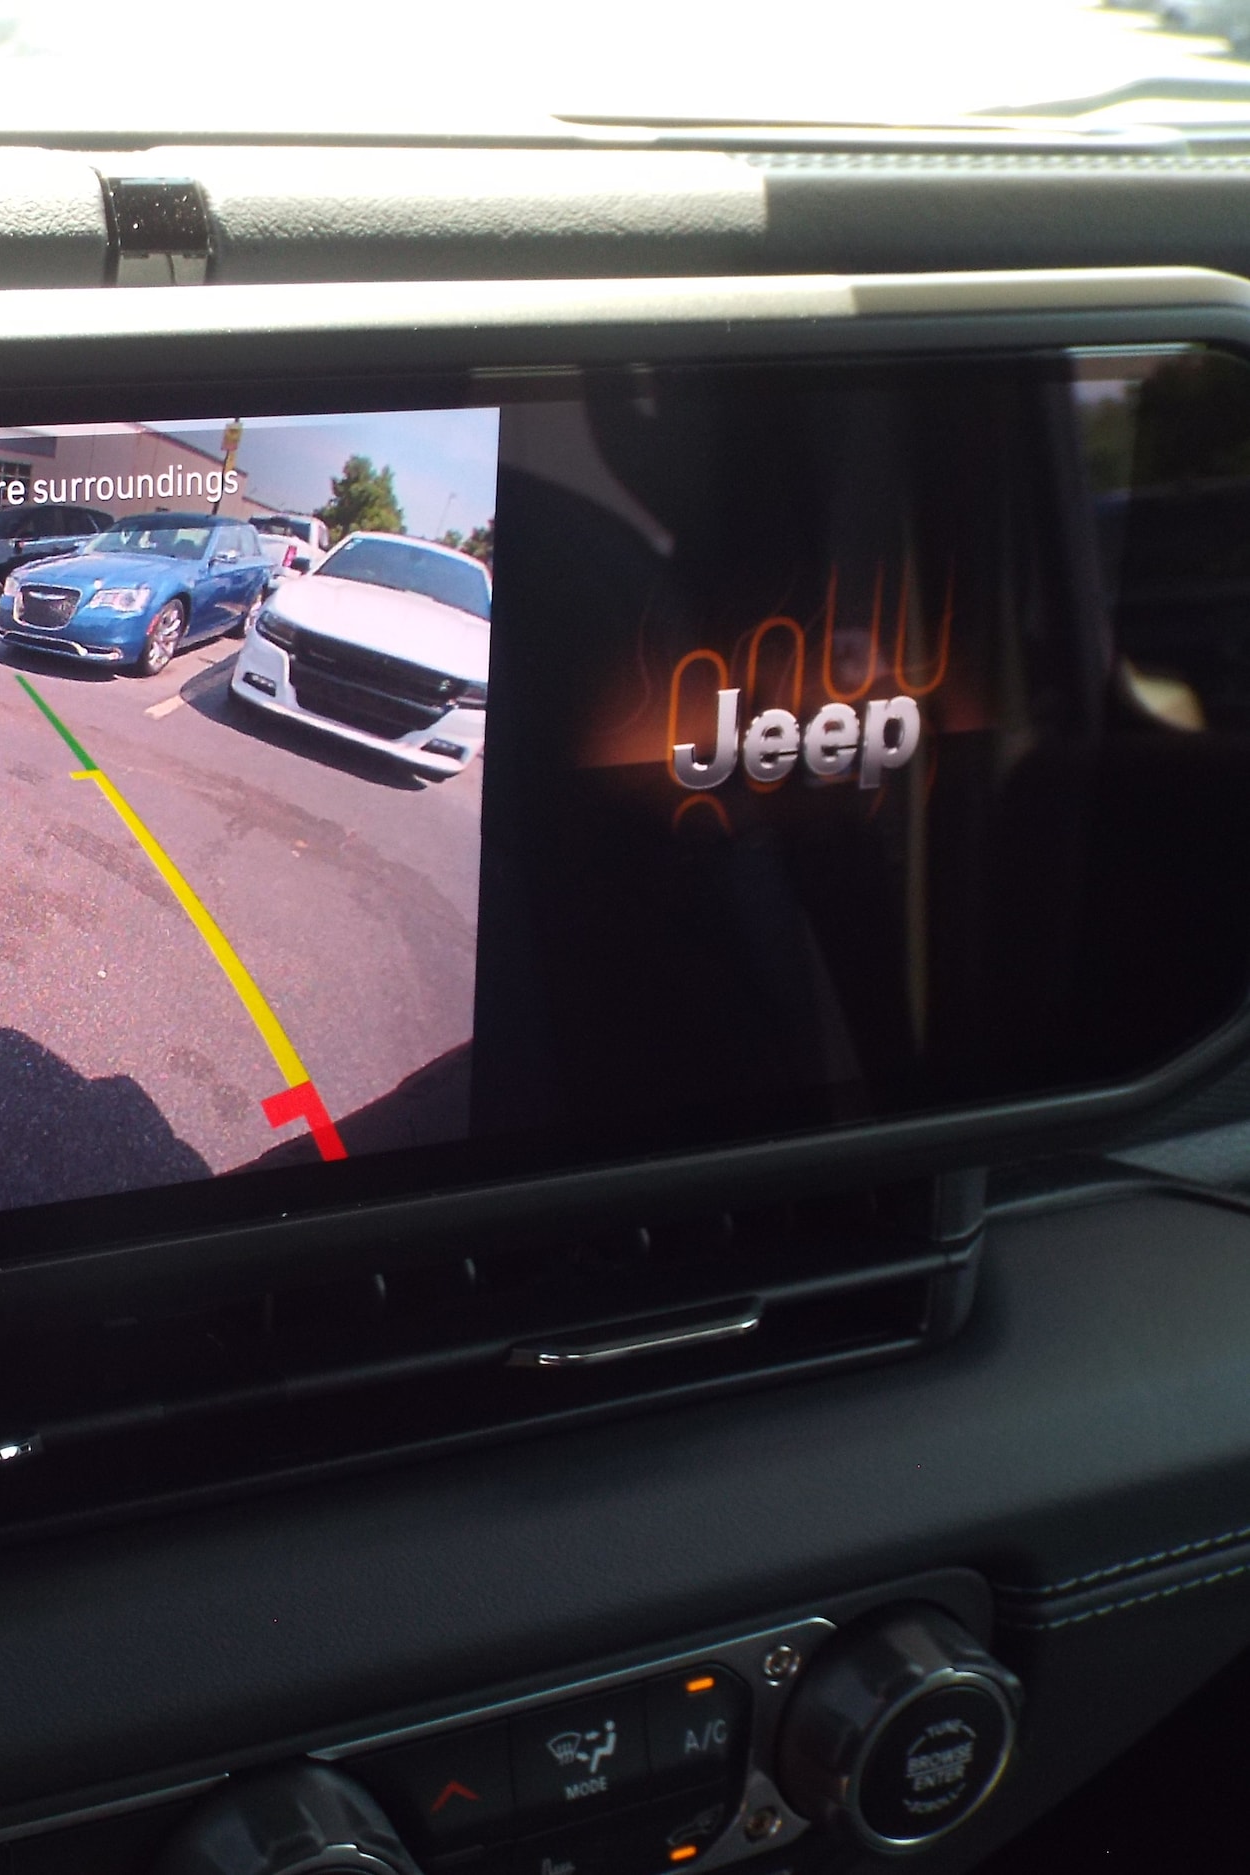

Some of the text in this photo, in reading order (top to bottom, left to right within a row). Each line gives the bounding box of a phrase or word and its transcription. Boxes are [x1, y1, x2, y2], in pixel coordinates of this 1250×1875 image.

[33, 463, 240, 505] surroundings
[672, 688, 921, 790] Jeep
[684, 1718, 728, 1754] A/C
[907, 1741, 974, 1775] BROWSE
[564, 1775, 608, 1801] MODE
[912, 1763, 966, 1792] ENTER
